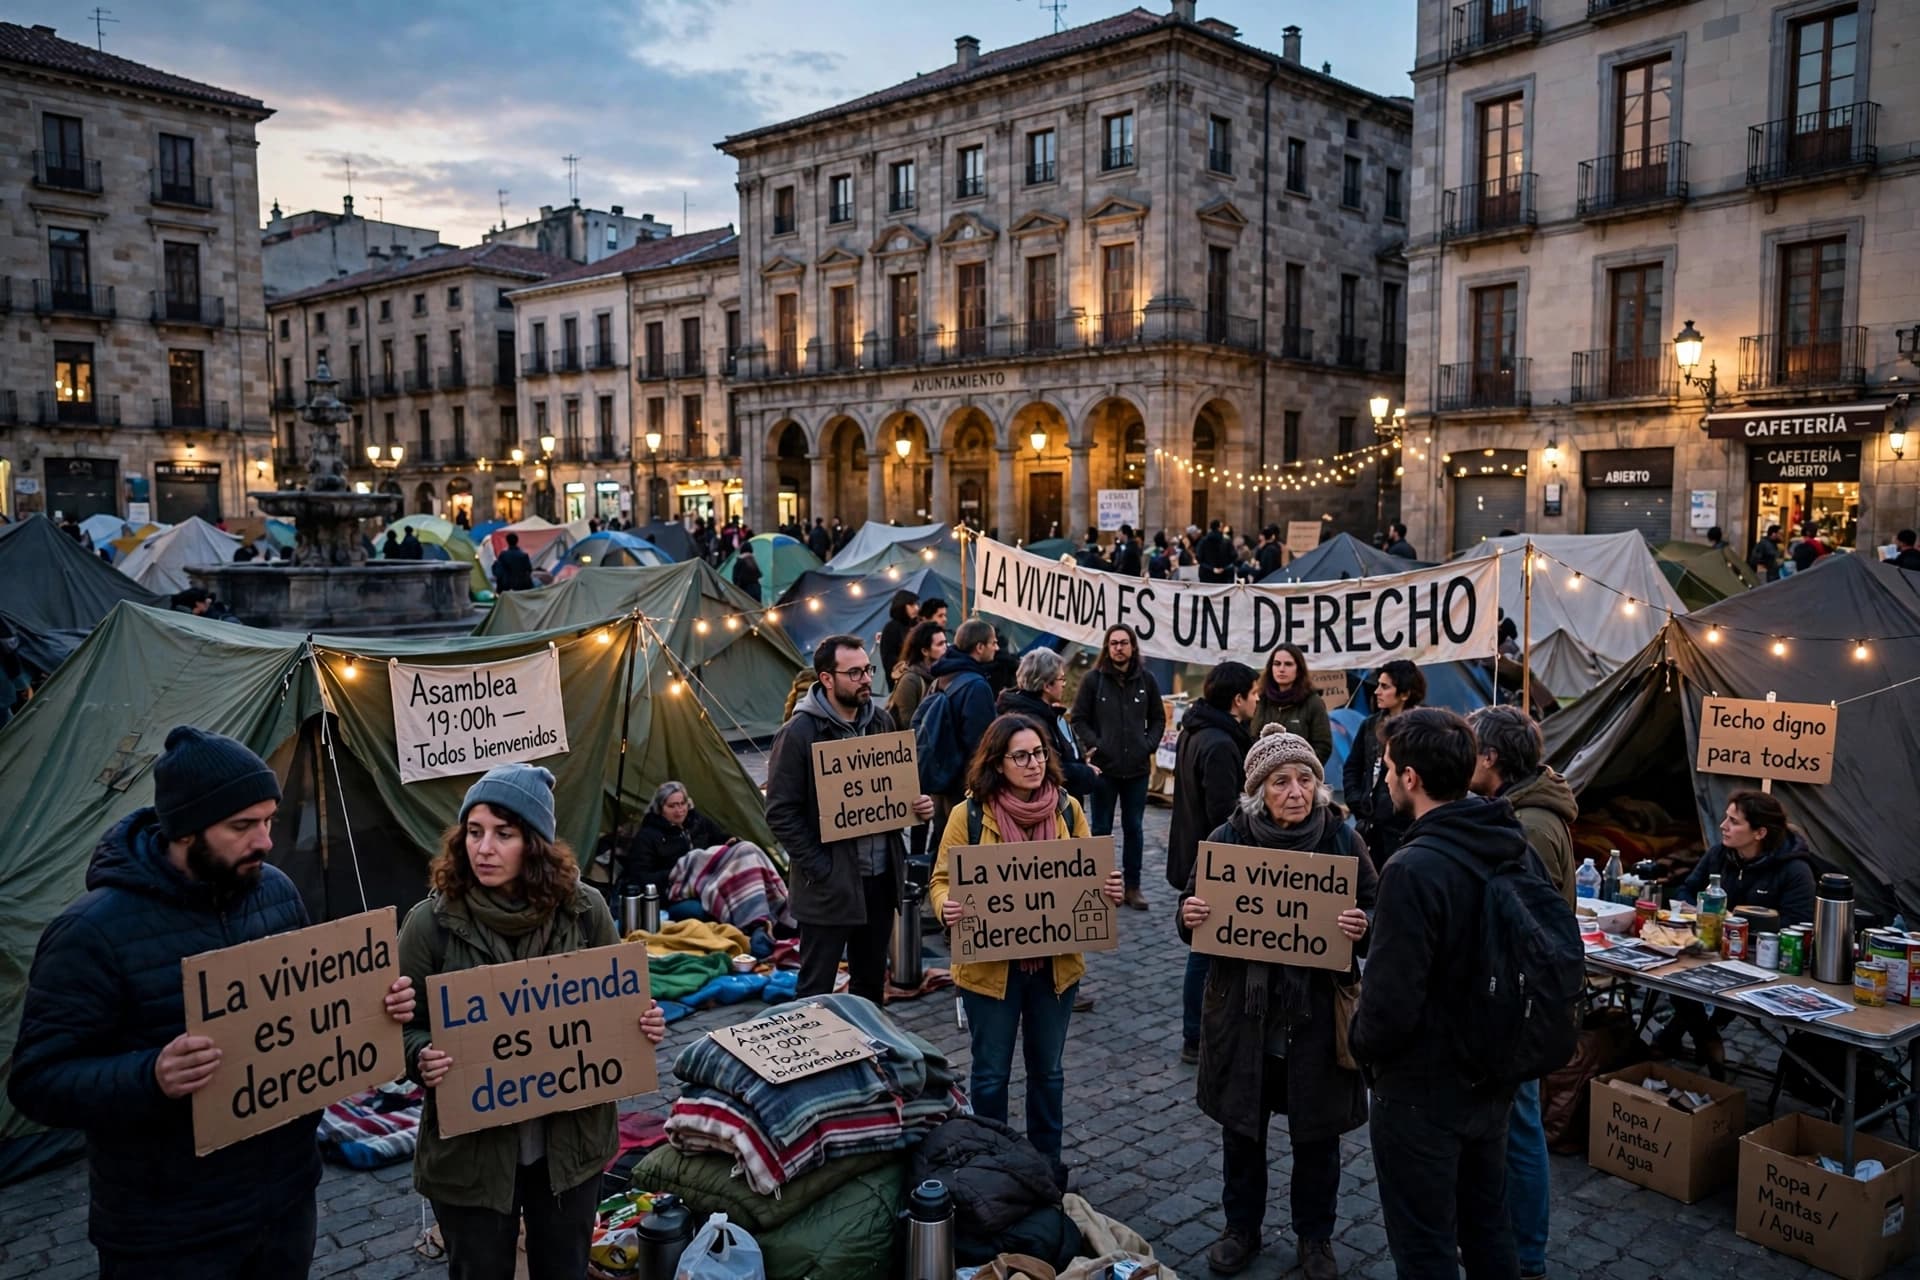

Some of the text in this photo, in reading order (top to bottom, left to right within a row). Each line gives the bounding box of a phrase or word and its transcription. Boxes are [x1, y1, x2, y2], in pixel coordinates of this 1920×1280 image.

[912, 372, 1005, 392] AYUNTAMIENTO
[1744, 413, 1847, 437] CAFETERÍA
[1767, 446, 1842, 464] CAFETERÍA
[1779, 464, 1828, 477] ABIERTO
[1605, 470, 1650, 483] ABIERTO
[982, 551, 1477, 653] LA VIVIENDA ES UN DERECHO
[410, 671, 517, 707] Asamblea
[426, 705, 497, 736] 19:00h
[1710, 705, 1826, 740] Techo digno
[413, 724, 558, 769] Todos bienvenidos
[819, 740, 913, 776] La vivienda
[1707, 747, 1820, 771] para todxs
[843, 775, 893, 798] es un
[834, 795, 907, 829] derecho
[956, 848, 1096, 886] La vivienda
[1205, 851, 1349, 896] La vivienda
[987, 890, 1055, 913] es un
[1235, 894, 1308, 920] es un
[973, 914, 1072, 949] derecho
[1216, 915, 1327, 955] derecho
[198, 927, 391, 1022] La vivienda
[440, 957, 640, 1029] La vivienda
[254, 998, 351, 1053] es un
[492, 1019, 592, 1060] es un
[765, 1048, 820, 1066] Todos
[771, 1047, 861, 1078] bienvenidos
[231, 1035, 377, 1119] derecho
[471, 1050, 622, 1113] derecho
[1612, 1102, 1648, 1130] Ropa
[1606, 1121, 1659, 1154] Mantas
[1616, 1147, 1654, 1173] Agua
[1767, 1163, 1810, 1197] Ropa
[1758, 1185, 1822, 1225] Mantas
[1769, 1214, 1816, 1246] Agua
